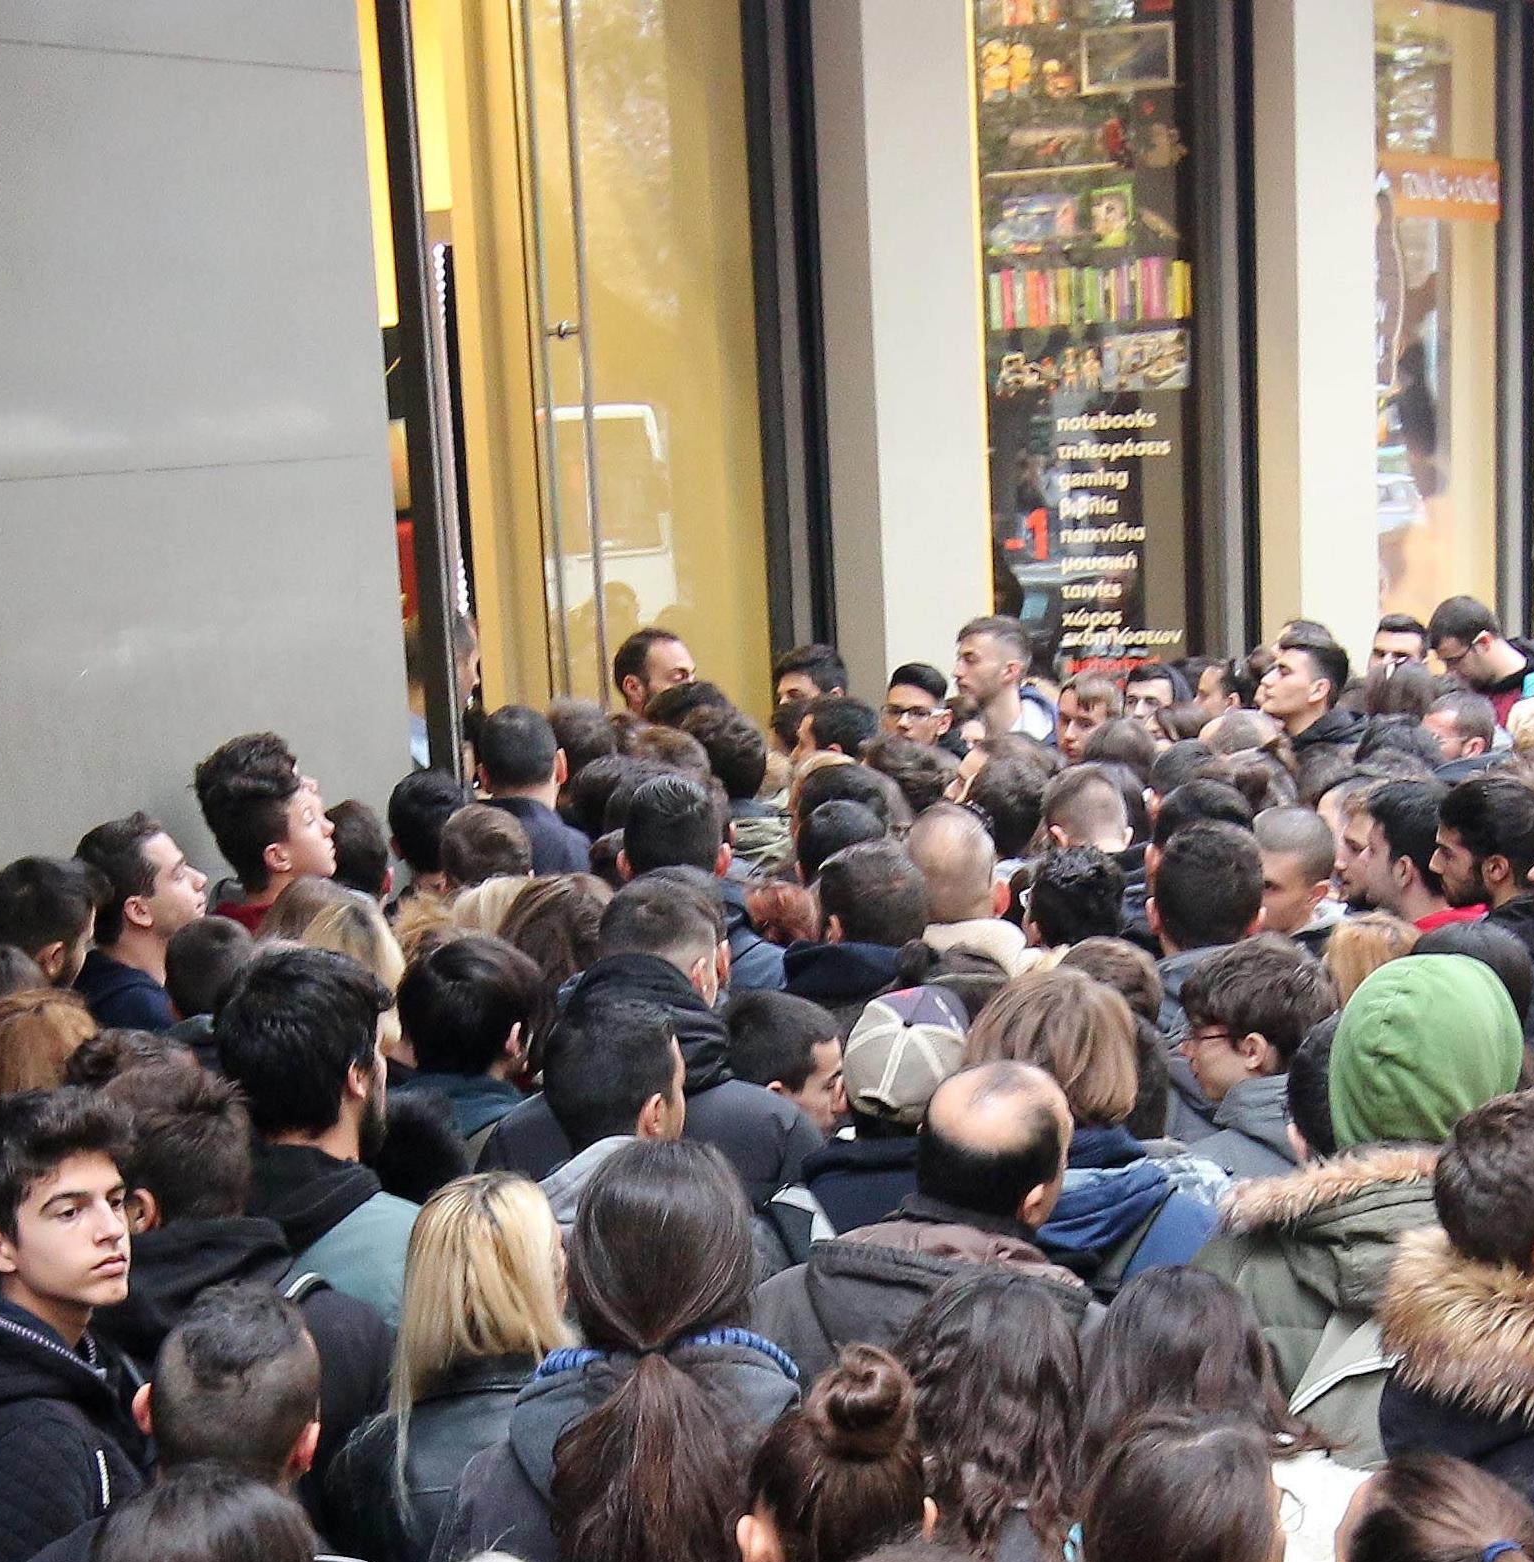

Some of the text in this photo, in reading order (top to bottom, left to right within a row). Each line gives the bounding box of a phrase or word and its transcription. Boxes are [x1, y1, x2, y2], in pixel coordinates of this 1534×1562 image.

[1056, 408, 1158, 432] notebooks
[1056, 438, 1172, 462] τηλεοράσεις
[1058, 467, 1129, 491] gaming
[1058, 495, 1119, 520] βιβλία
[1059, 521, 1146, 544] παιχνίδια
[1060, 550, 1139, 575] μουσική
[1060, 577, 1123, 600] ταινίες
[1061, 607, 1123, 632] χώρος
